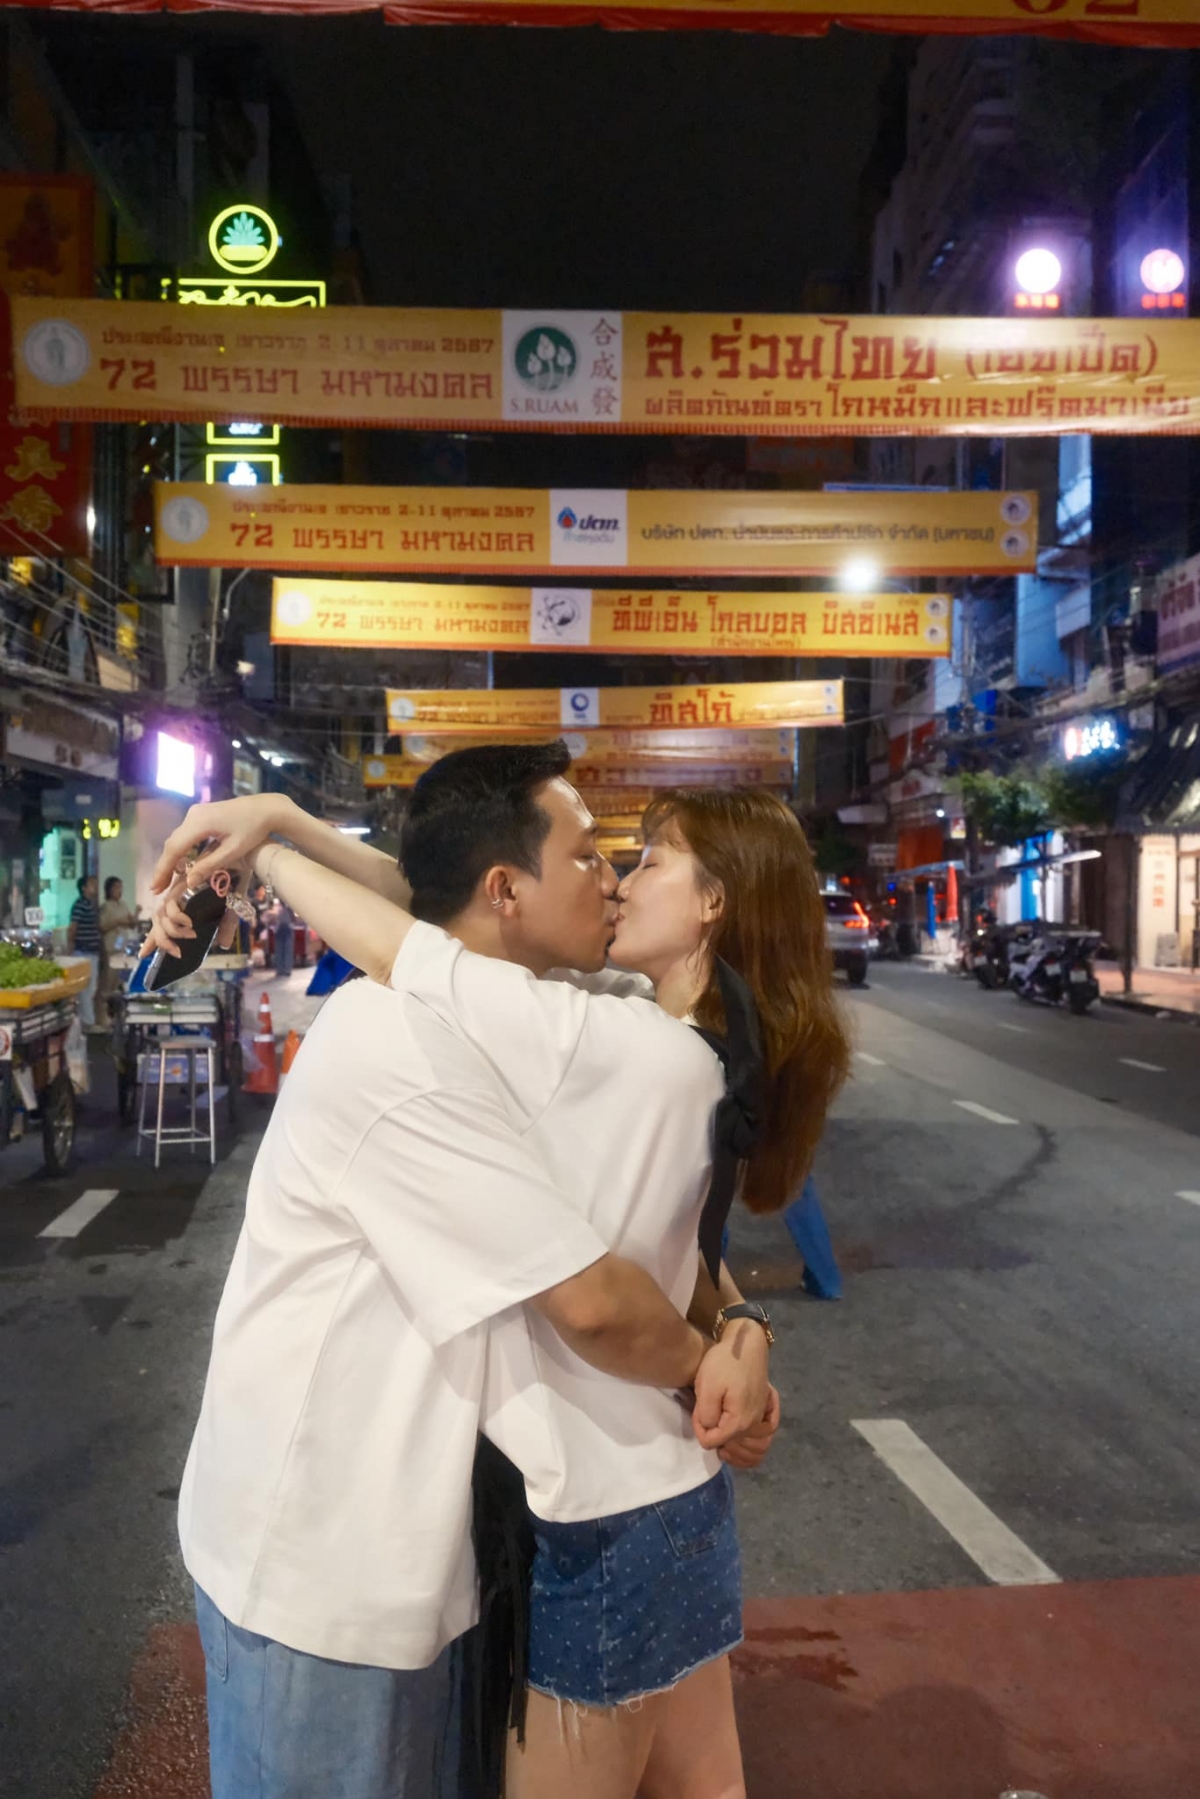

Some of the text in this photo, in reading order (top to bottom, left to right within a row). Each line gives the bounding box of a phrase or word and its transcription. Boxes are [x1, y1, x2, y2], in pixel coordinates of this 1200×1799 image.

[645, 318, 934, 380] ส.ร่วมไทย
[100, 358, 494, 400] 72 พรรษา มหามงคล
[230, 523, 535, 552] 72 พรรษา มหามงคล
[317, 612, 347, 629] 72
